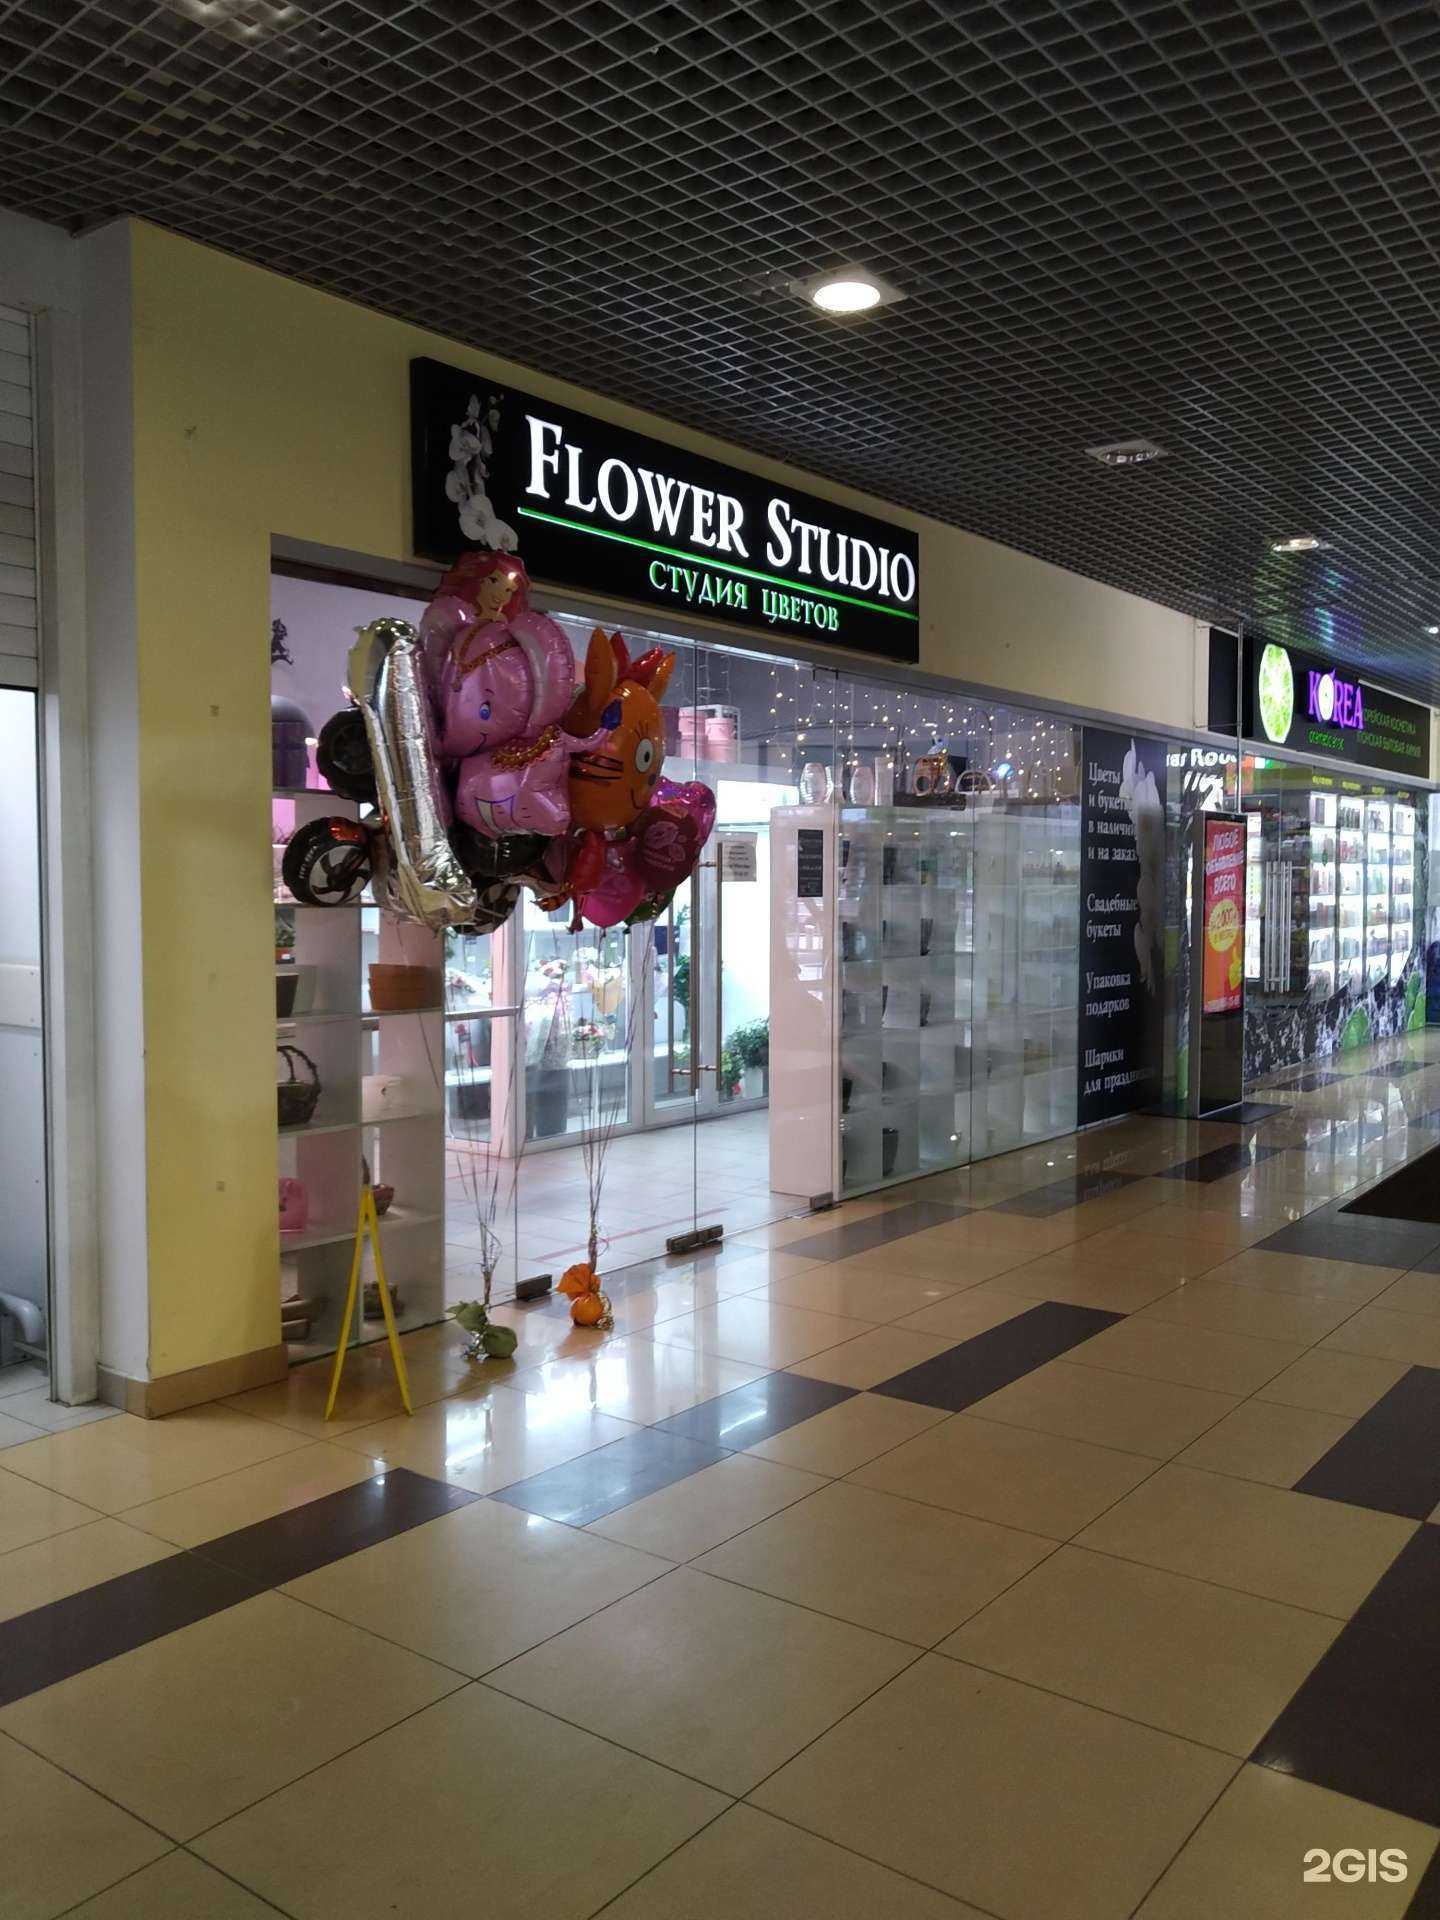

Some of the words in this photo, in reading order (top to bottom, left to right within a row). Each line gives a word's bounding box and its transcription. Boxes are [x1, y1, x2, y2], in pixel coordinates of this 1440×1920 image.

[524, 414, 750, 559] FLOWER
[766, 497, 917, 602] STUDIO
[648, 559, 749, 611] СТУДИЯ
[761, 588, 840, 632] ЦВЕТОВ
[1308, 669, 1364, 730] KOREA
[1088, 762, 1121, 786] Цветы
[1088, 793, 1095, 808] и
[1088, 820, 1095, 833] в
[1088, 846, 1095, 860] и
[1098, 847, 1110, 860] на
[1086, 920, 1123, 943] букеты
[1086, 971, 1131, 994] Упаковка
[1085, 997, 1130, 1018] подарков
[1084, 1048, 1124, 1070] Шарики
[1083, 1079, 1101, 1096] для
